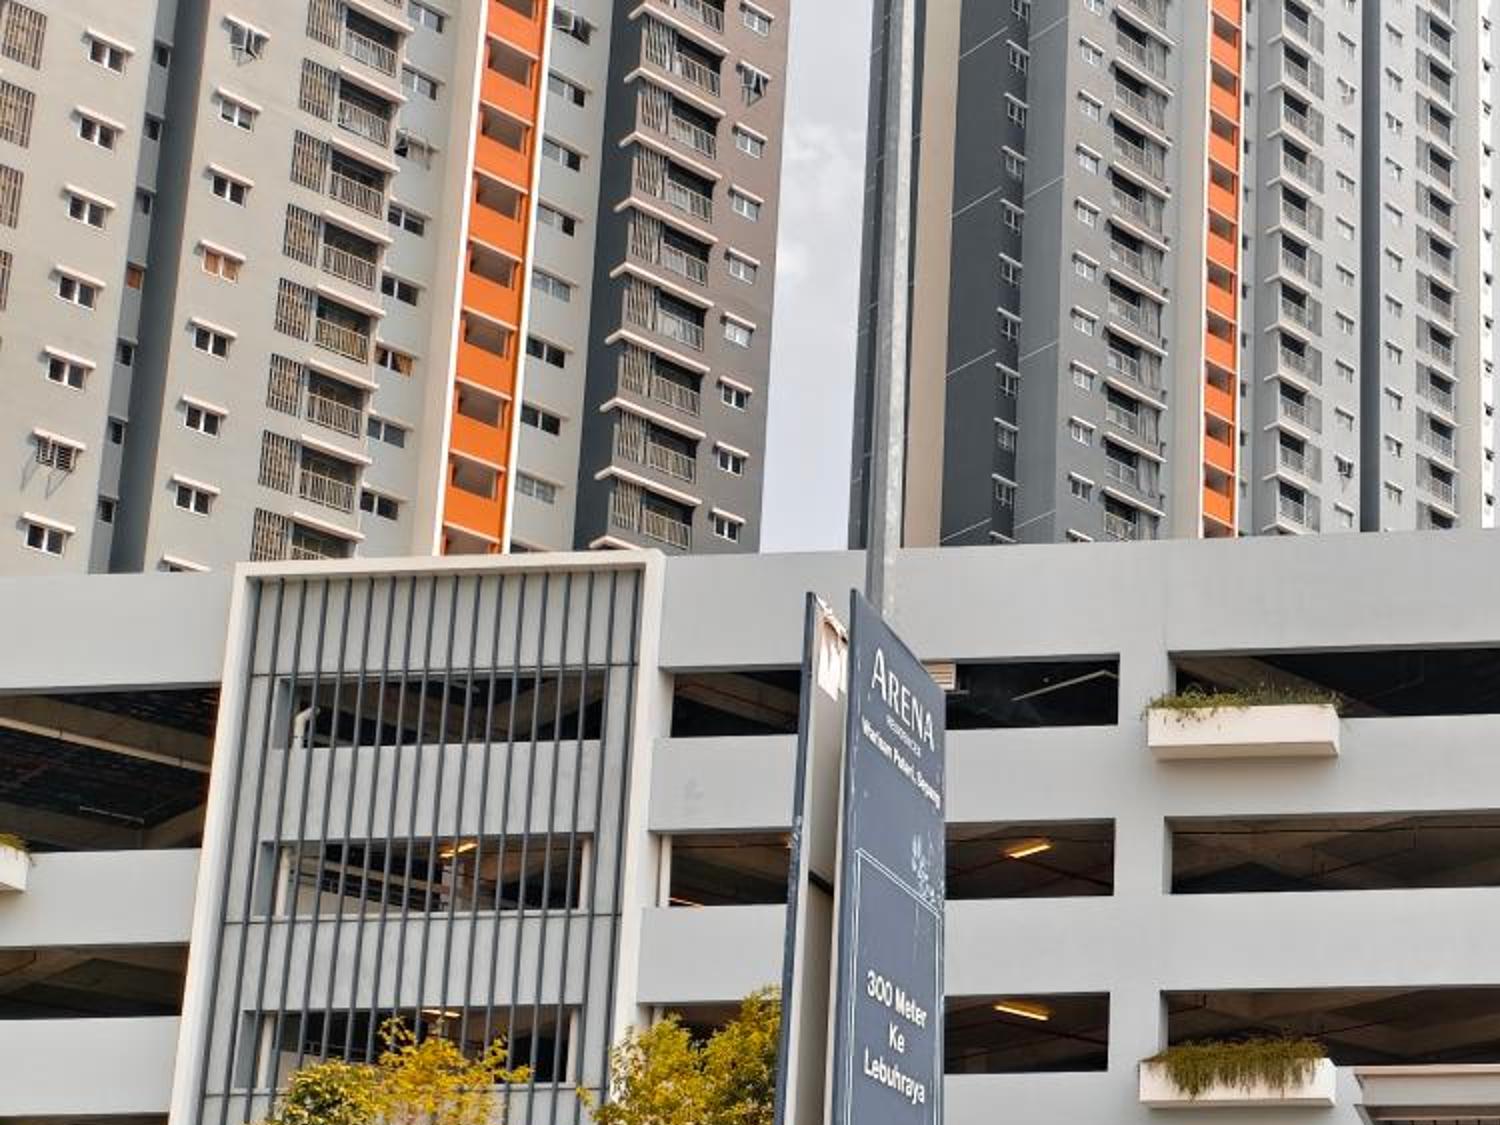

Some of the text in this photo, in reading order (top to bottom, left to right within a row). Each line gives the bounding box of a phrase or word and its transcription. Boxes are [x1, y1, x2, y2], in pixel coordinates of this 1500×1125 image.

[871, 648, 935, 753] ARENA
[867, 969, 927, 1028] 300 Meter
[889, 1021, 905, 1053] Ke
[864, 1045, 925, 1104] Lebuhraya
